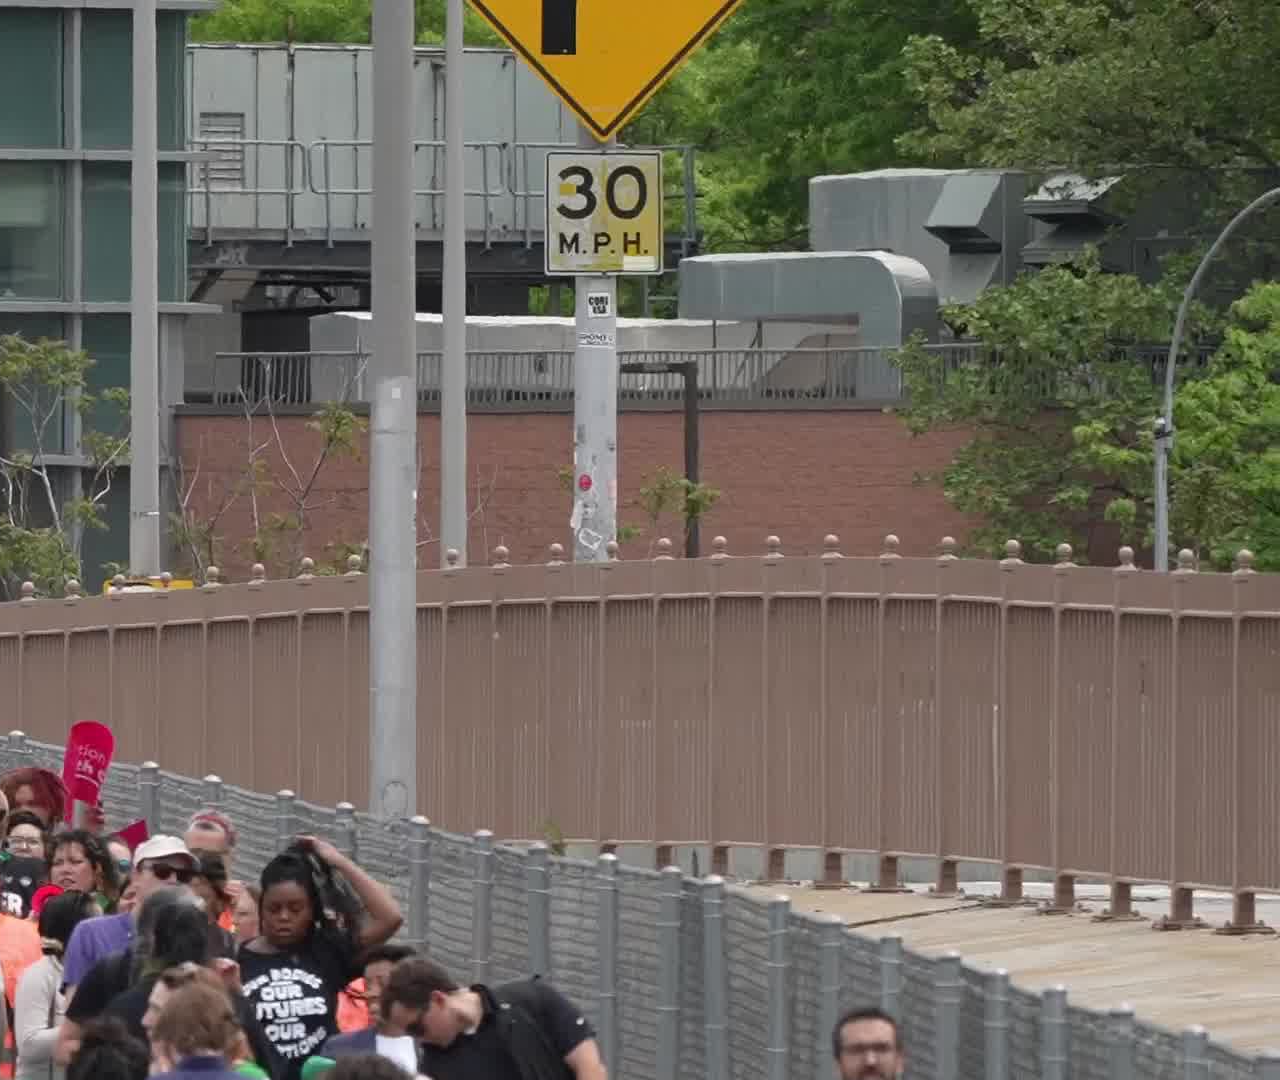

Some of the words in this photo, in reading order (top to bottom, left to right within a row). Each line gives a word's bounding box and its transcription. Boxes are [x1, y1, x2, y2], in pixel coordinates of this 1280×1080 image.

[556, 165, 647, 219] 30
[559, 232, 648, 254] M.P.H.
[261, 984, 304, 1001] OUR
[265, 1022, 307, 1042] OUR
